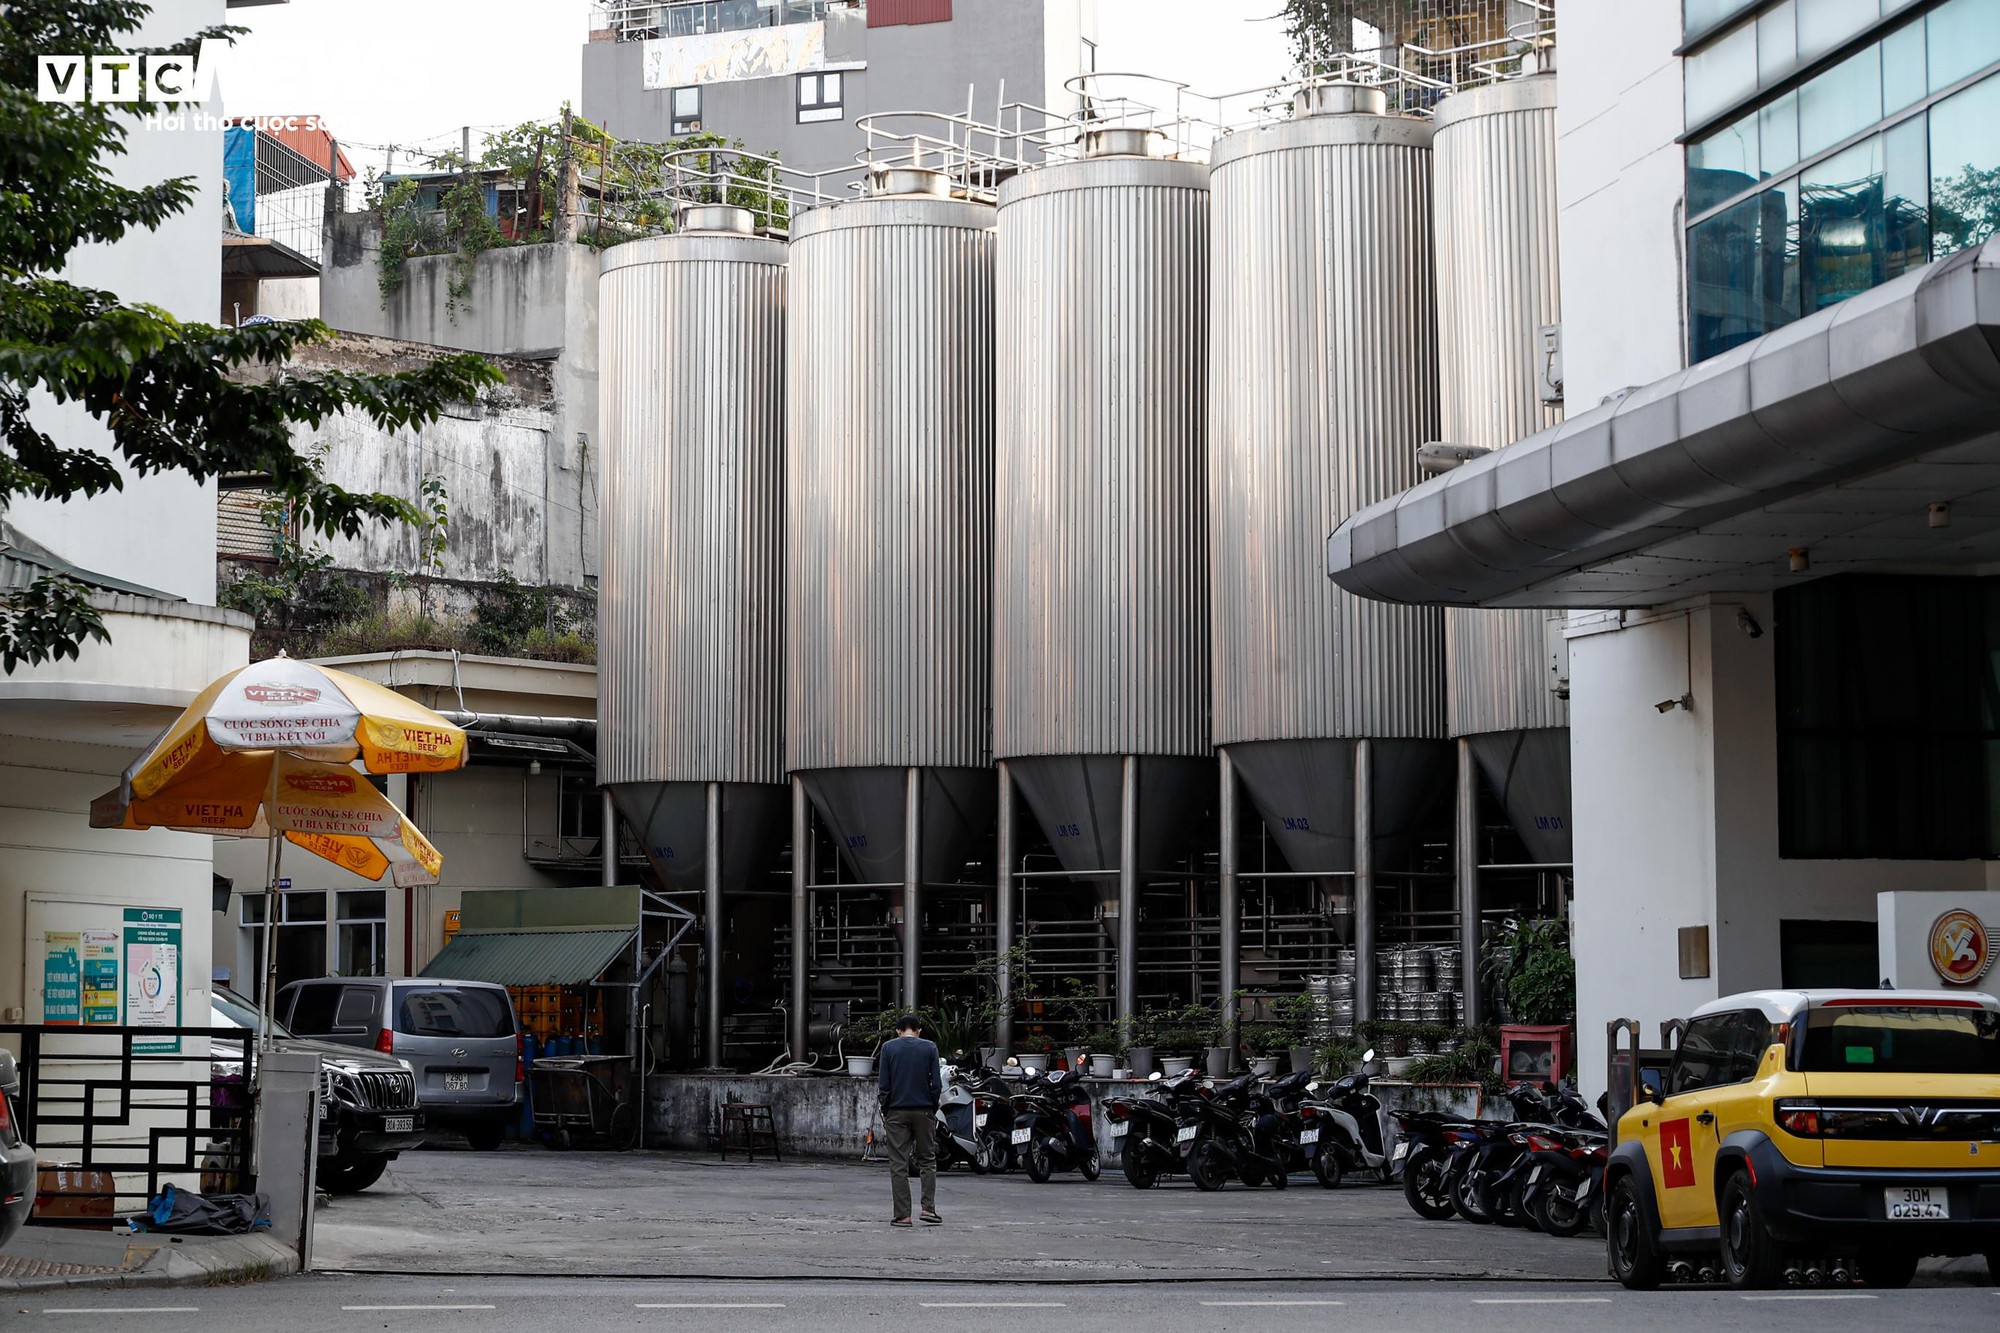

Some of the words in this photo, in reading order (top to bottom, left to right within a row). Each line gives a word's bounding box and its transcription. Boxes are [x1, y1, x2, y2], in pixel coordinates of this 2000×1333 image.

[260, 716, 292, 728] SỐNG
[312, 718, 340, 728] CHIA
[256, 732, 275, 741] BIA
[278, 728, 302, 740] KẾT
[304, 728, 325, 740] NỐI
[404, 729, 432, 744] VIET
[434, 732, 452, 746] HA
[418, 744, 438, 752] BEER
[162, 745, 183, 769] VIET
[185, 804, 220, 816] VIET
[224, 805, 244, 817] HA
[356, 811, 382, 821] CHIA
[201, 816, 226, 824] BEER
[306, 820, 322, 829] BIA
[1282, 817, 1296, 830] LM
[1297, 818, 1309, 830] 03
[1535, 816, 1550, 830] LM
[1550, 816, 1563, 829] 01
[1056, 825, 1068, 836] LM
[1069, 824, 1080, 836] 05
[1903, 1189, 1930, 1202] 30M
[1893, 1204, 1941, 1217] 029.47
